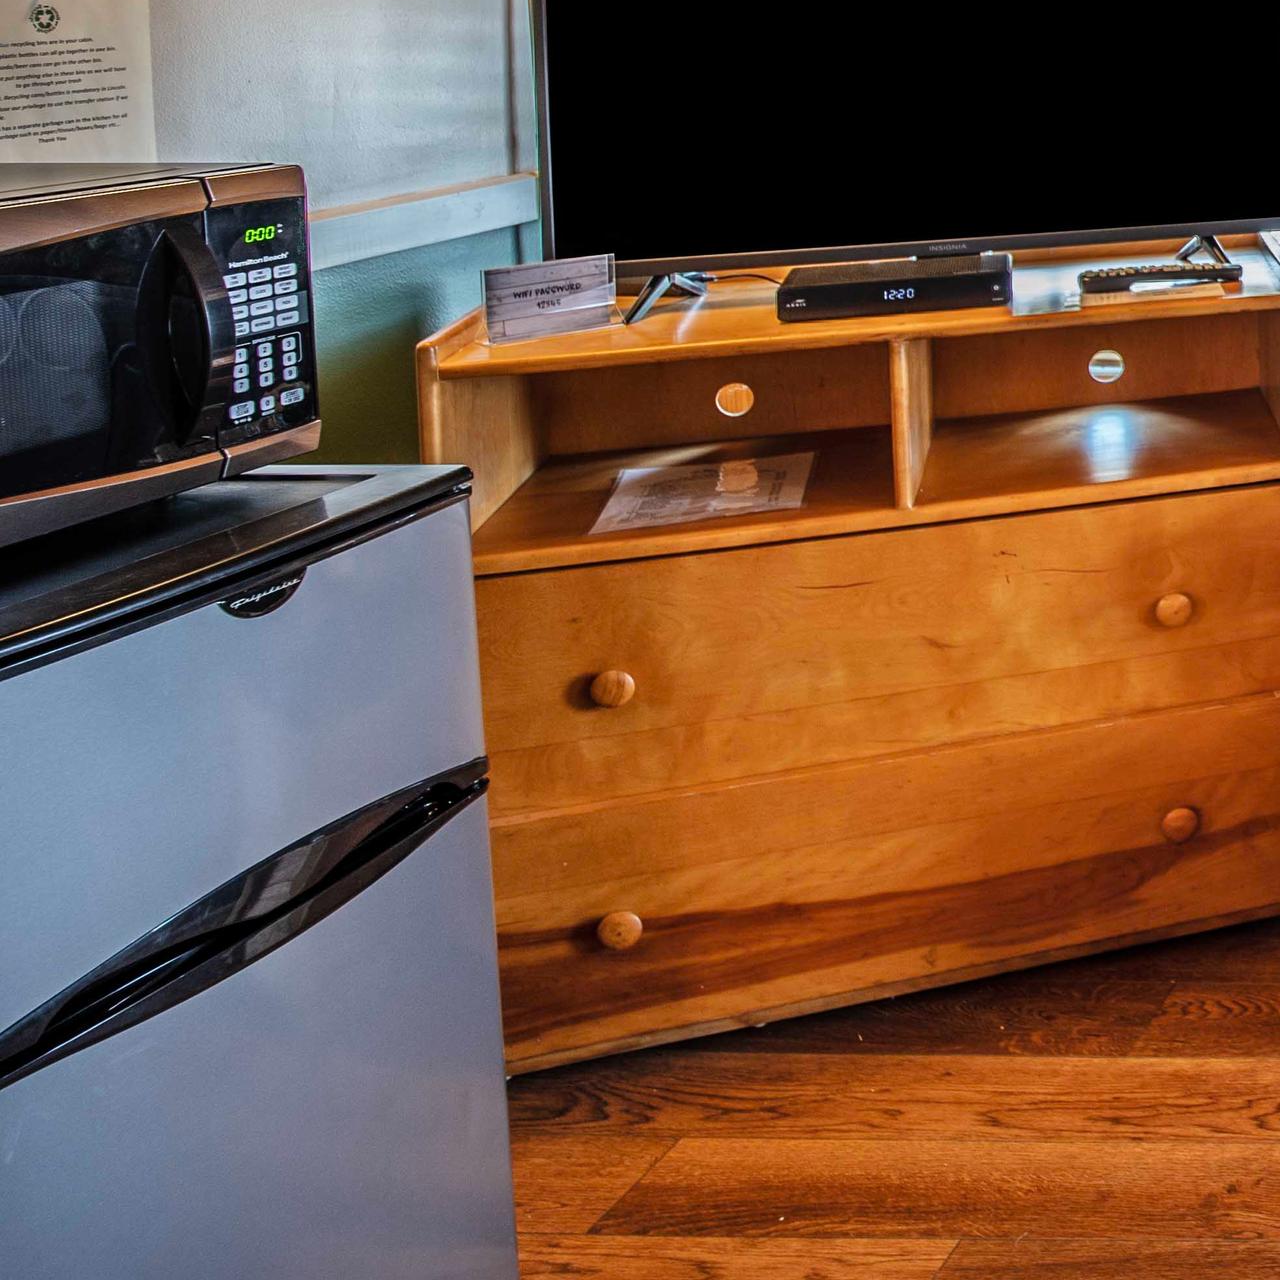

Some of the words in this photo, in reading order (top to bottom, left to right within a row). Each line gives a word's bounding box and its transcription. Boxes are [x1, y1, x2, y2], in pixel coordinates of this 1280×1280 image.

[245, 225, 275, 243] 0:00
[928, 243, 967, 252] INSIGNIA
[228, 257, 264, 269] Hamilton
[263, 252, 288, 263] Beach
[513, 289, 532, 299] WIFI
[535, 282, 582, 296] PASSWORD
[883, 288, 915, 300] 12:20
[537, 298, 562, 309] 12345
[229, 578, 301, 610] Frigidaire
